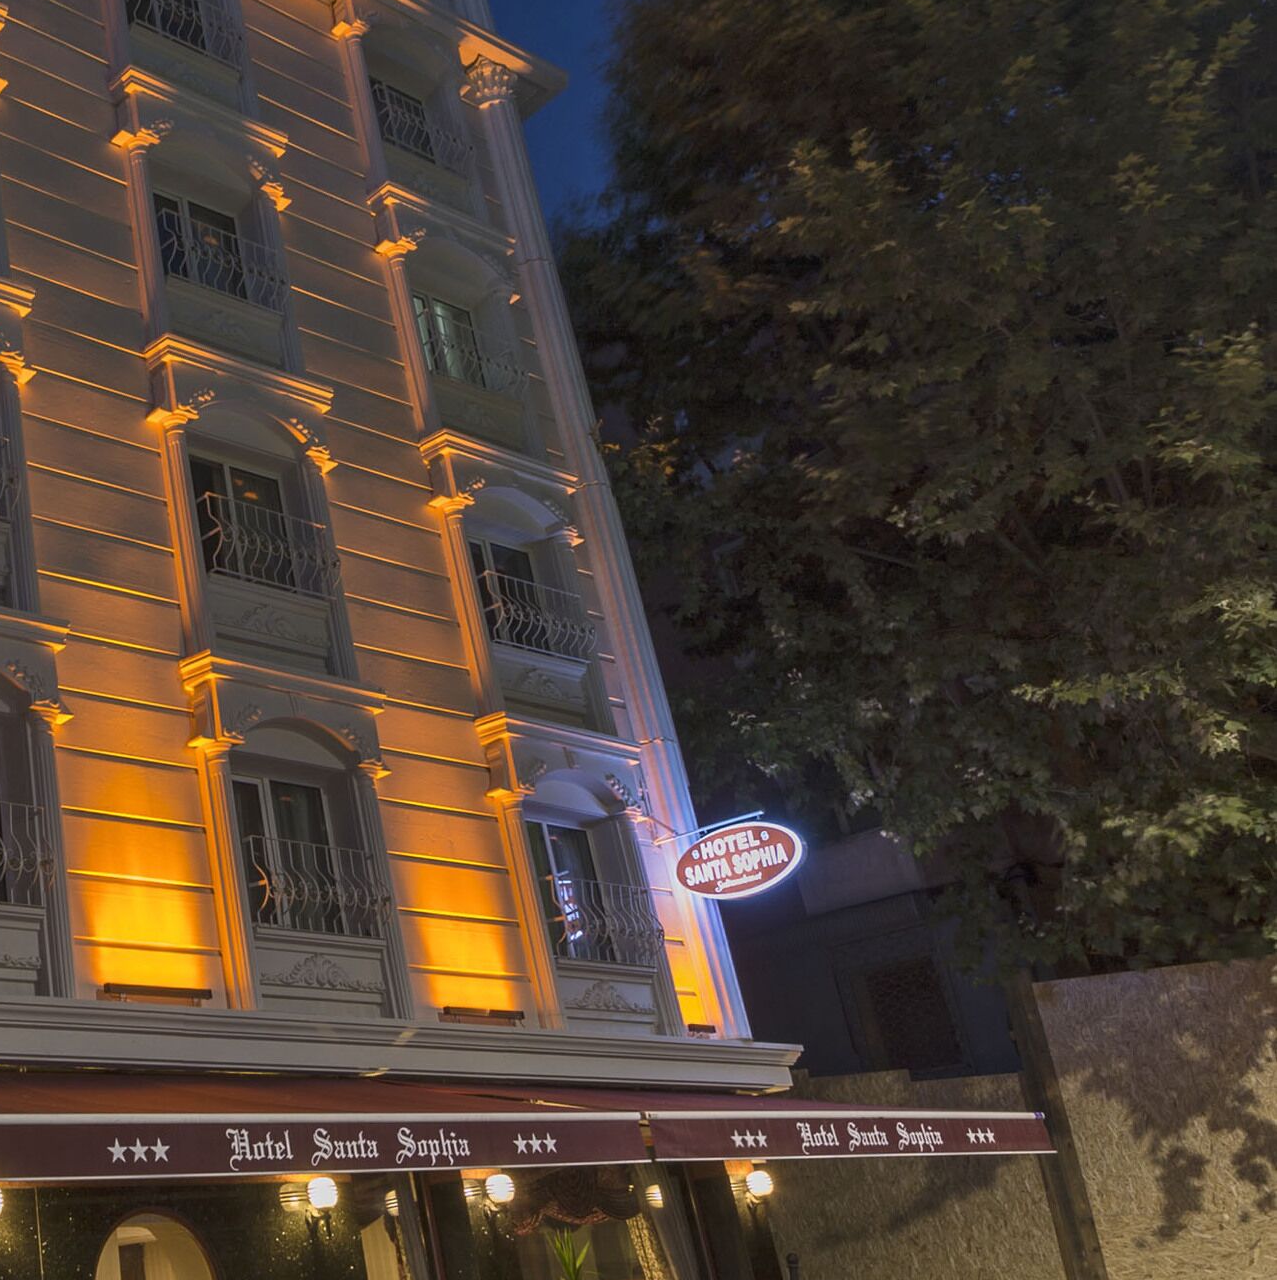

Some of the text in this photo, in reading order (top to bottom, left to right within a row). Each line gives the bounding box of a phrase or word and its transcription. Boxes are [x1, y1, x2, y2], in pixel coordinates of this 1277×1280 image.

[699, 830, 760, 860] HOTEL
[684, 858, 732, 887] SANTA
[731, 843, 789, 874] SOPHIA
[225, 1126, 472, 1171] Hotel Santa Sophia
[796, 1121, 944, 1156] Hotel Santa Sophia
